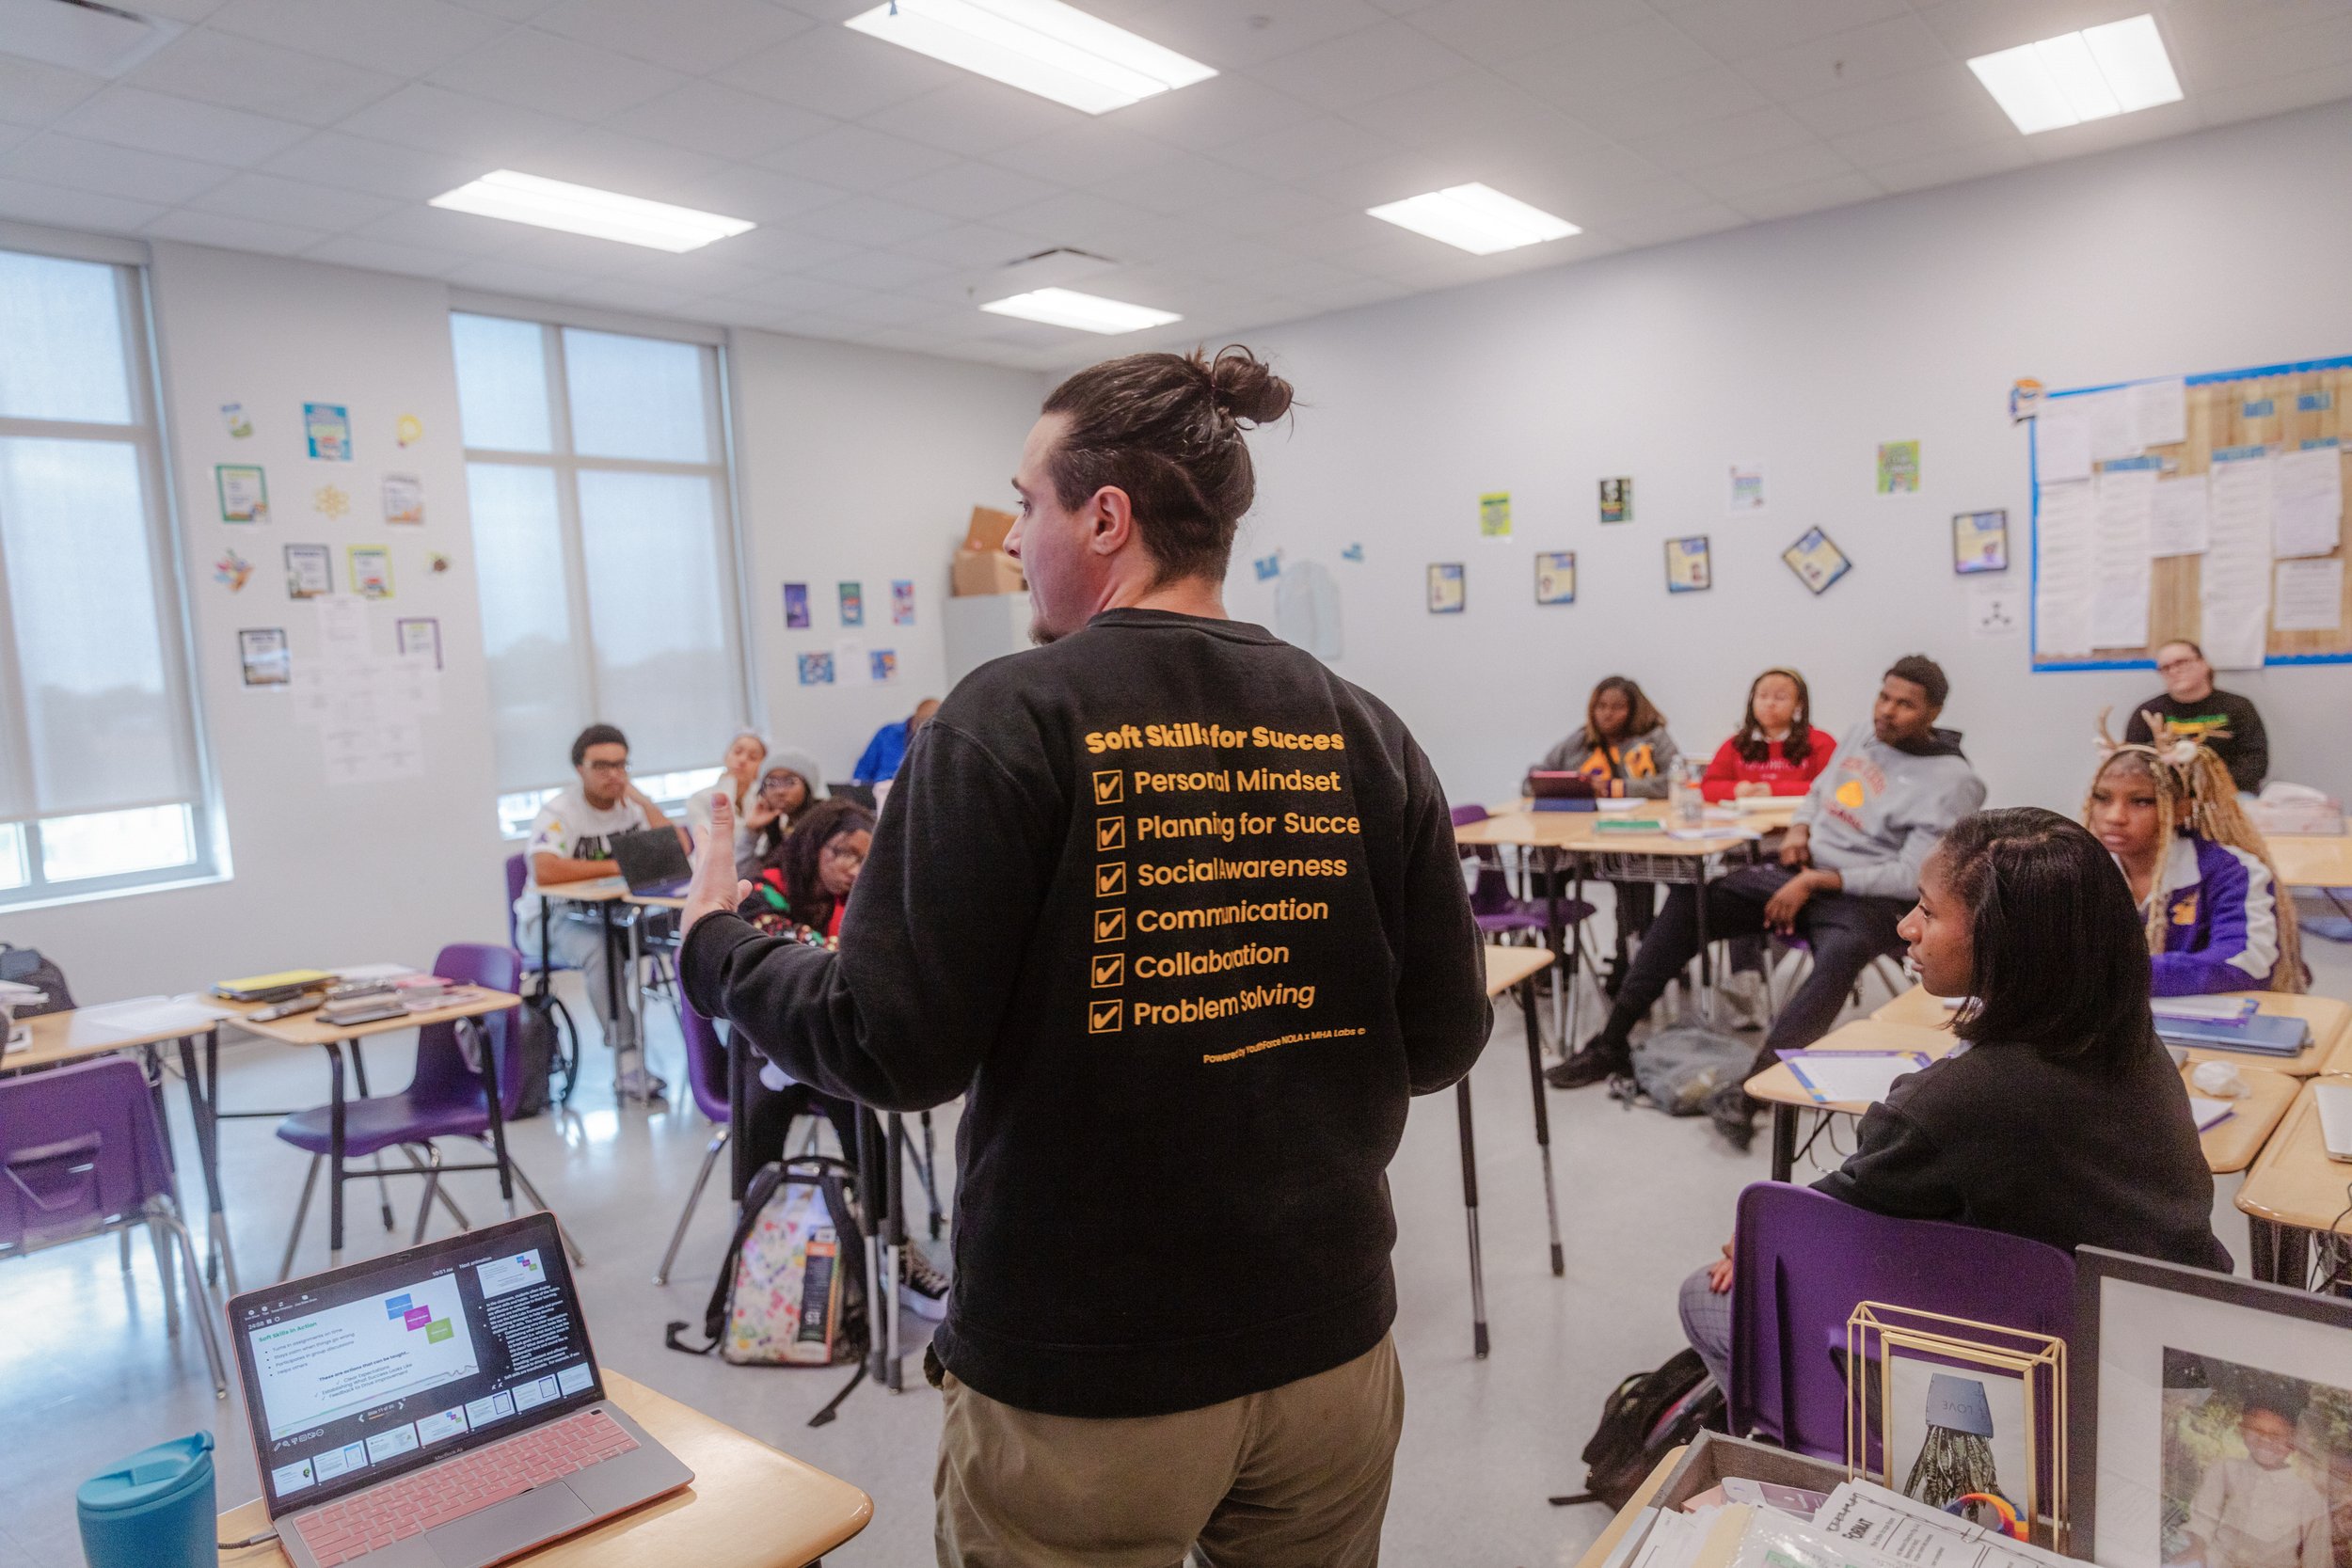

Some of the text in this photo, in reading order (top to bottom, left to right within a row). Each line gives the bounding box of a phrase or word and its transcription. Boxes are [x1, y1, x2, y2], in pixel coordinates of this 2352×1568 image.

[1085, 722, 1144, 753] Soft
[1144, 721, 1210, 747] Skills
[1209, 723, 1248, 748] for
[1236, 767, 1342, 793] Mindset
[1239, 812, 1277, 834] for
[1137, 857, 1217, 887] Social
[1136, 896, 1328, 932] Communication
[1134, 982, 1316, 1026] Problem Solving
[1280, 1033, 1304, 1045] NOLA
[1304, 1033, 1311, 1041] x
[1311, 1030, 1333, 1040] MHA
[1333, 1028, 1357, 1037] Labs
[272, 1329, 289, 1338] Skills
[296, 1322, 316, 1331] Action
[1941, 1399, 1973, 1416] LOVE
